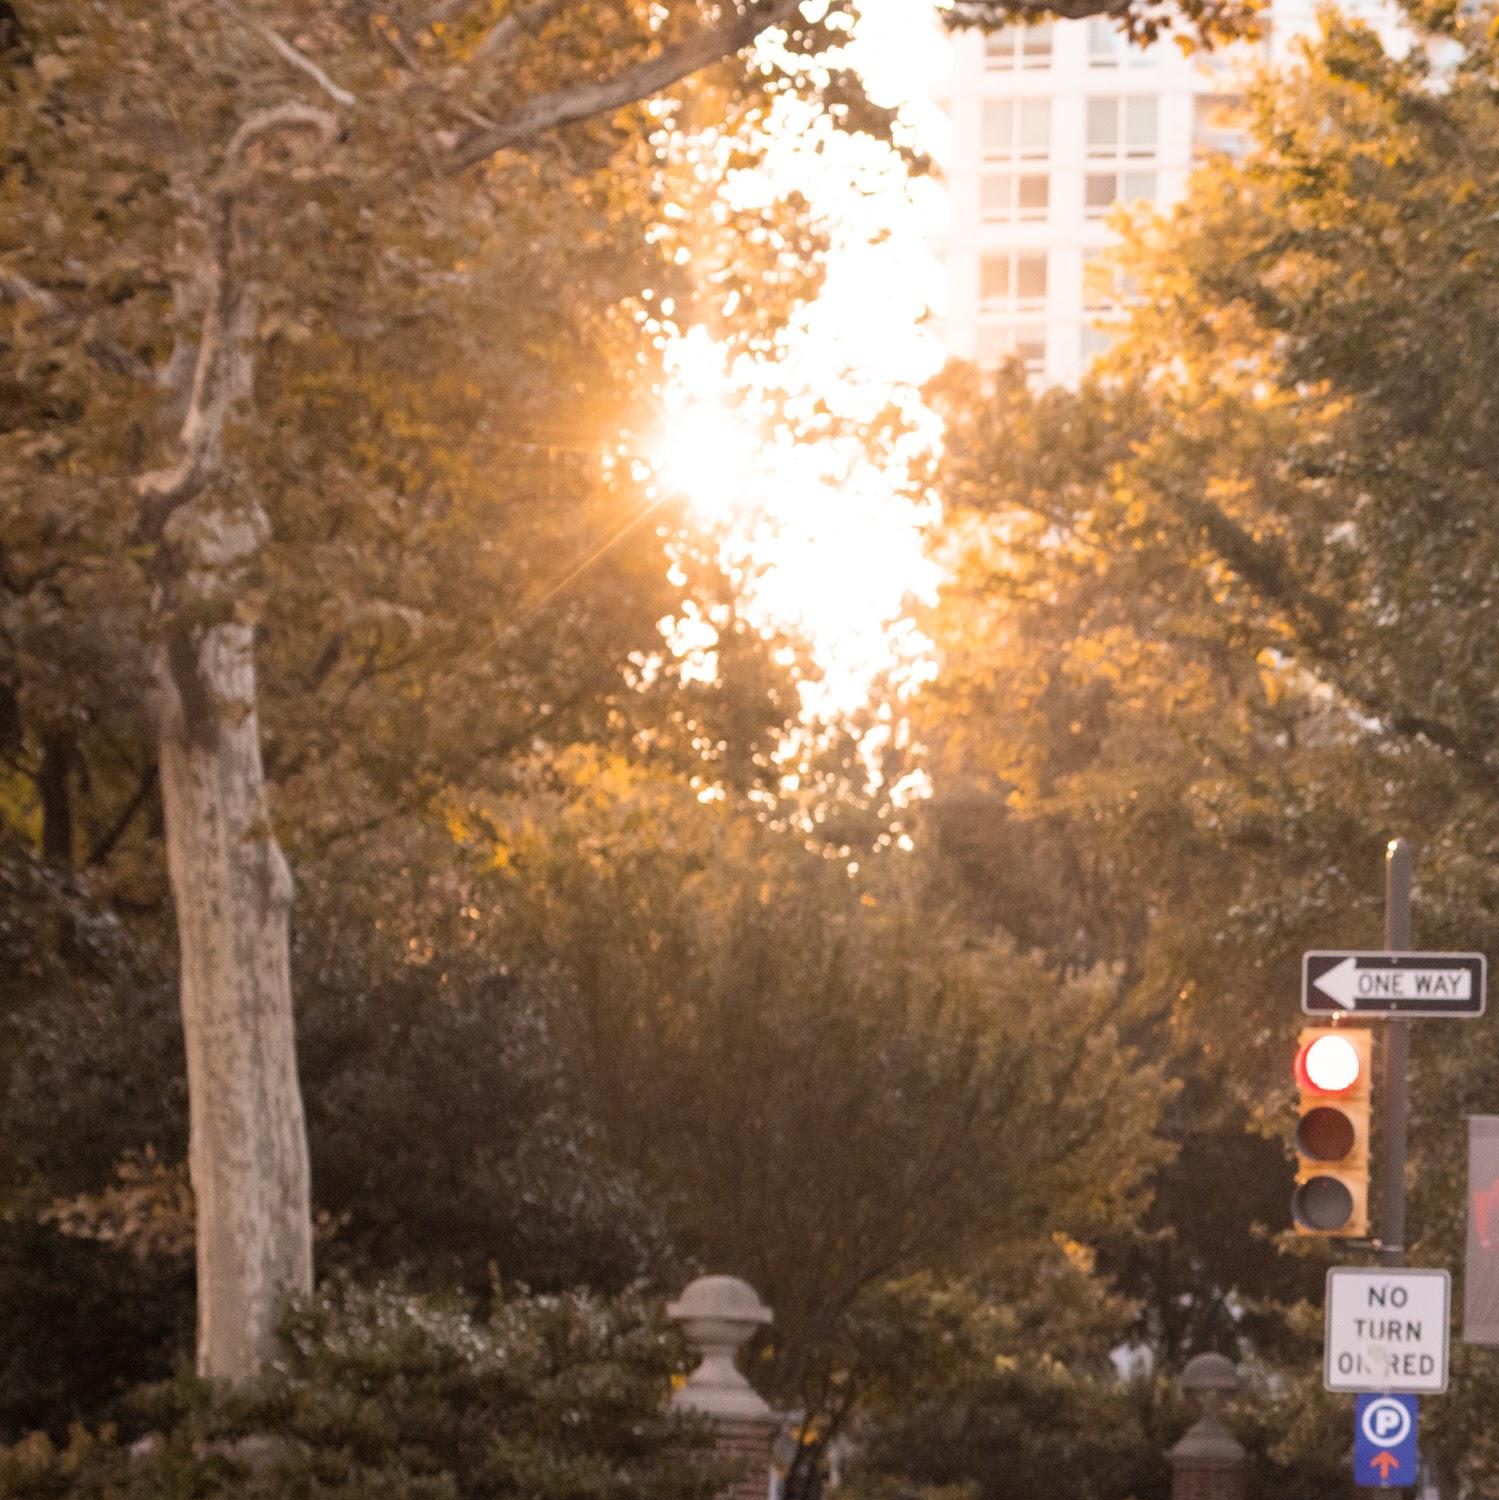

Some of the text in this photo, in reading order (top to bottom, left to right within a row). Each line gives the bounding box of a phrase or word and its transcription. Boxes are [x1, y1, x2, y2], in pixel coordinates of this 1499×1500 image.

[1358, 973, 1462, 995] ONE WAY
[1368, 1285, 1408, 1309] NO
[1354, 1318, 1422, 1342] TURN
[1385, 1353, 1435, 1378] RED
[1375, 1408, 1401, 1437] P
